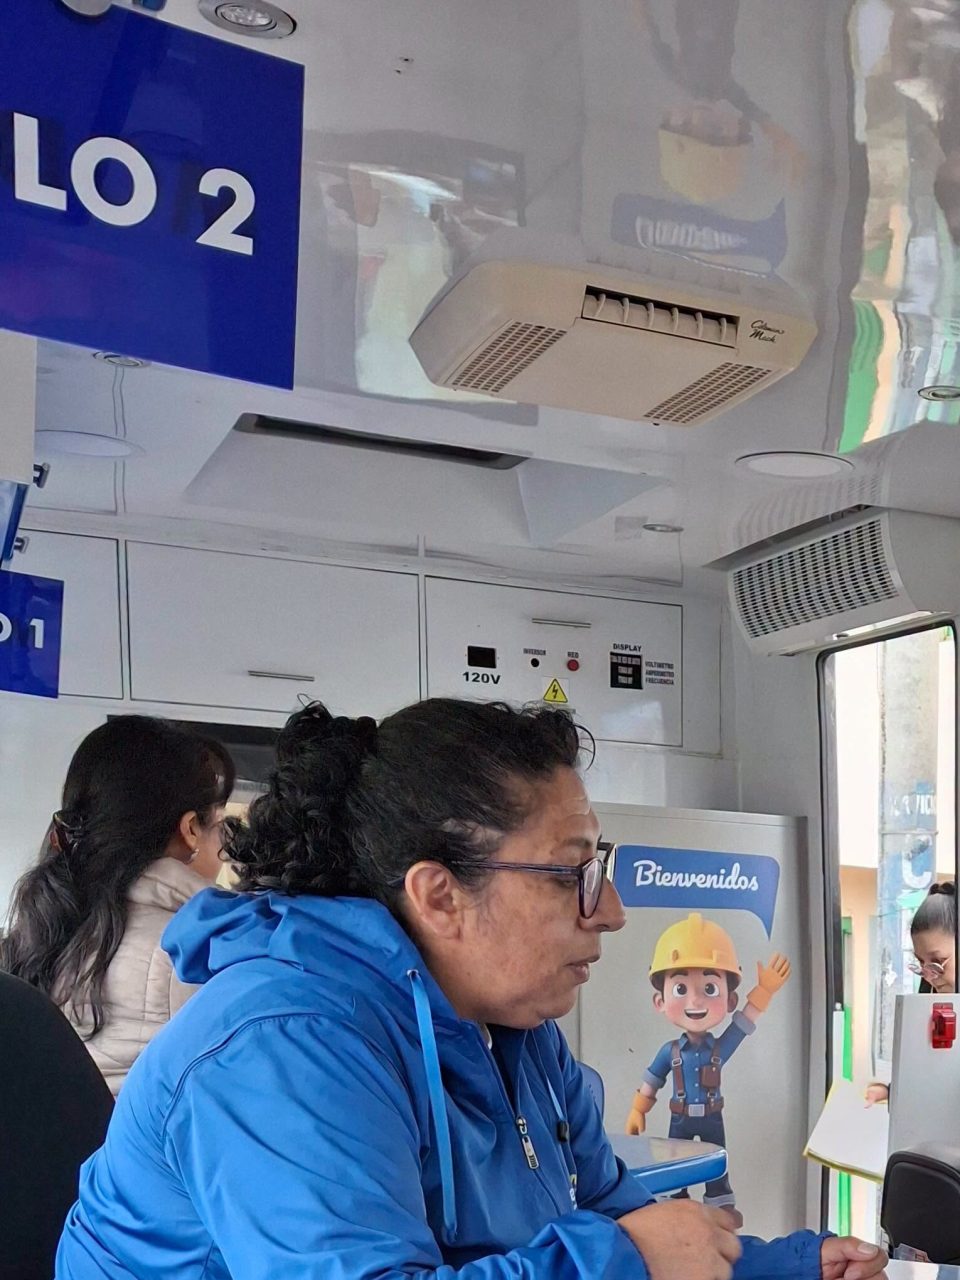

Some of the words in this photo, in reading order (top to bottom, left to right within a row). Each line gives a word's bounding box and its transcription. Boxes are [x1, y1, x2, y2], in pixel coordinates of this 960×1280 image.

[13, 111, 157, 226] LO
[195, 167, 256, 256] 2
[29, 618, 45, 649] 1
[612, 643, 642, 652] DISPLAY
[462, 671, 501, 685] 120V
[633, 859, 759, 891] Bienvenidos
